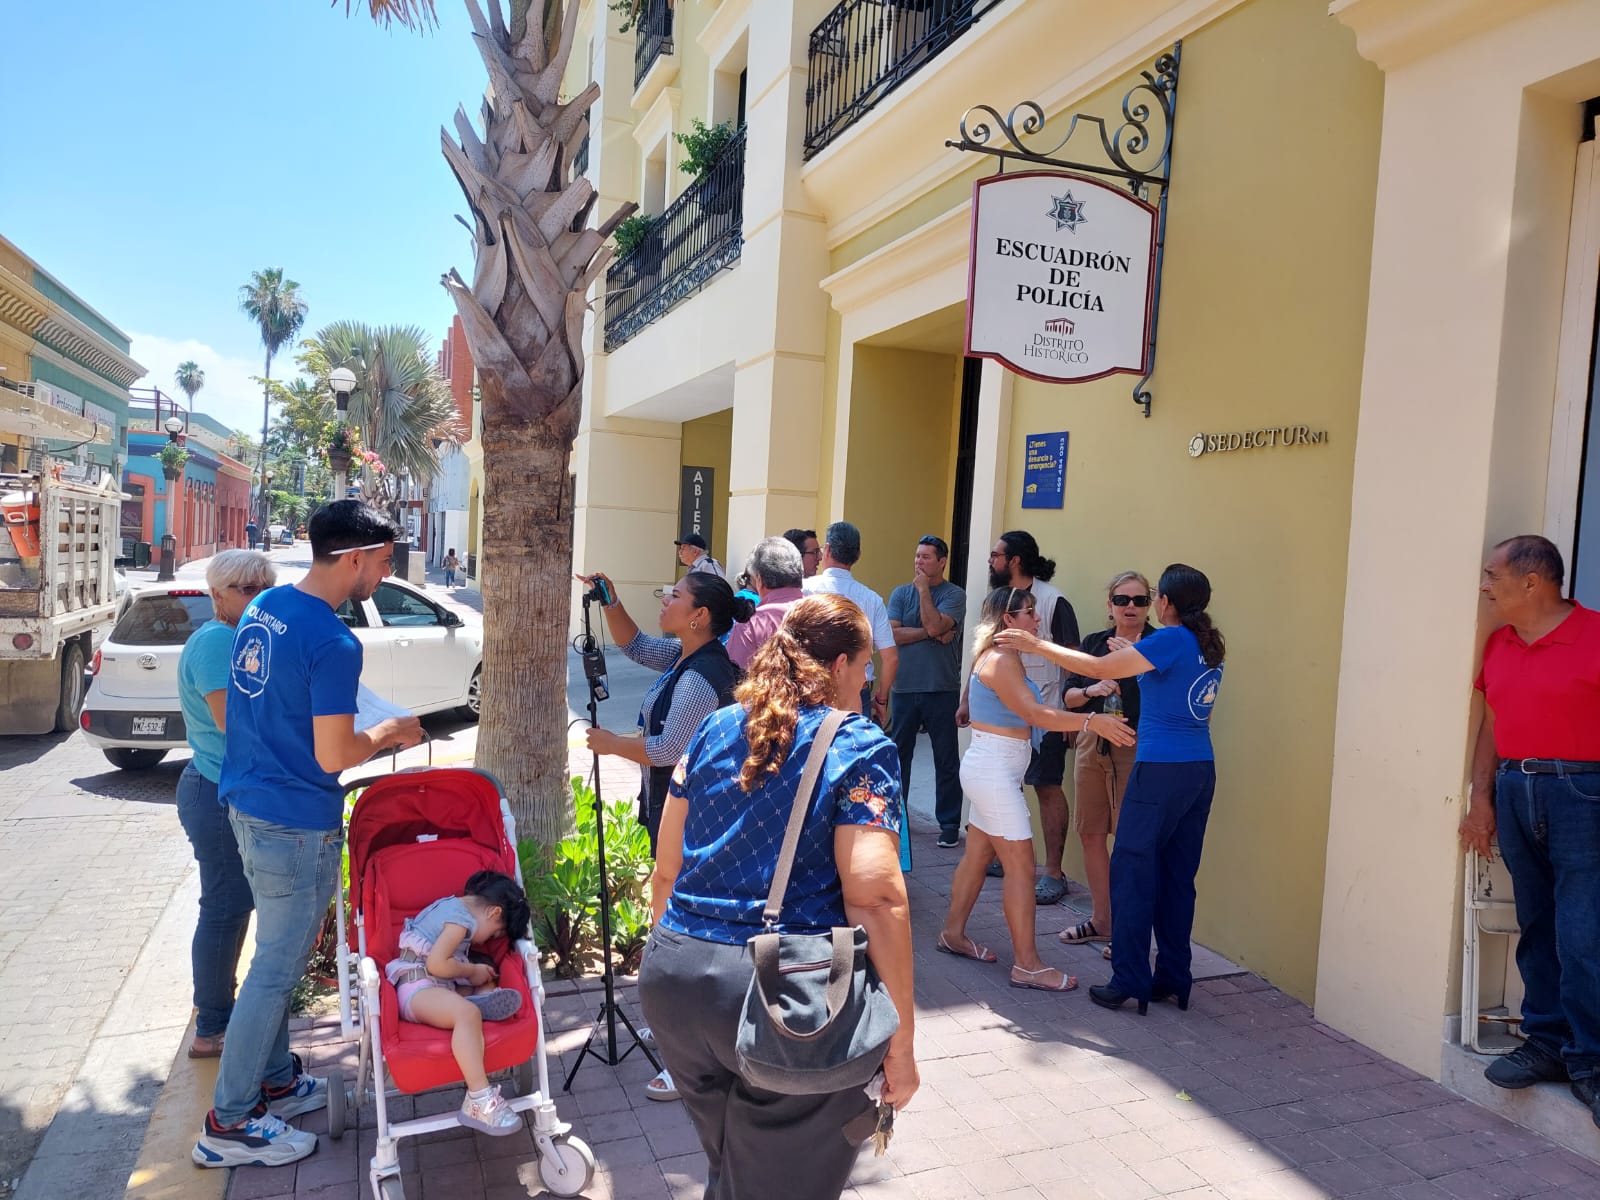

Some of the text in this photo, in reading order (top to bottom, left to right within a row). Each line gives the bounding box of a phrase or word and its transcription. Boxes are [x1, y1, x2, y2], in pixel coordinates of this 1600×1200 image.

[995, 237, 1131, 273] ESCUADRÓN
[1049, 267, 1081, 288] DE
[1016, 284, 1105, 312] POLICÍA
[1207, 425, 1310, 452] SEDECTUR
[693, 470, 704, 535] ABIER
